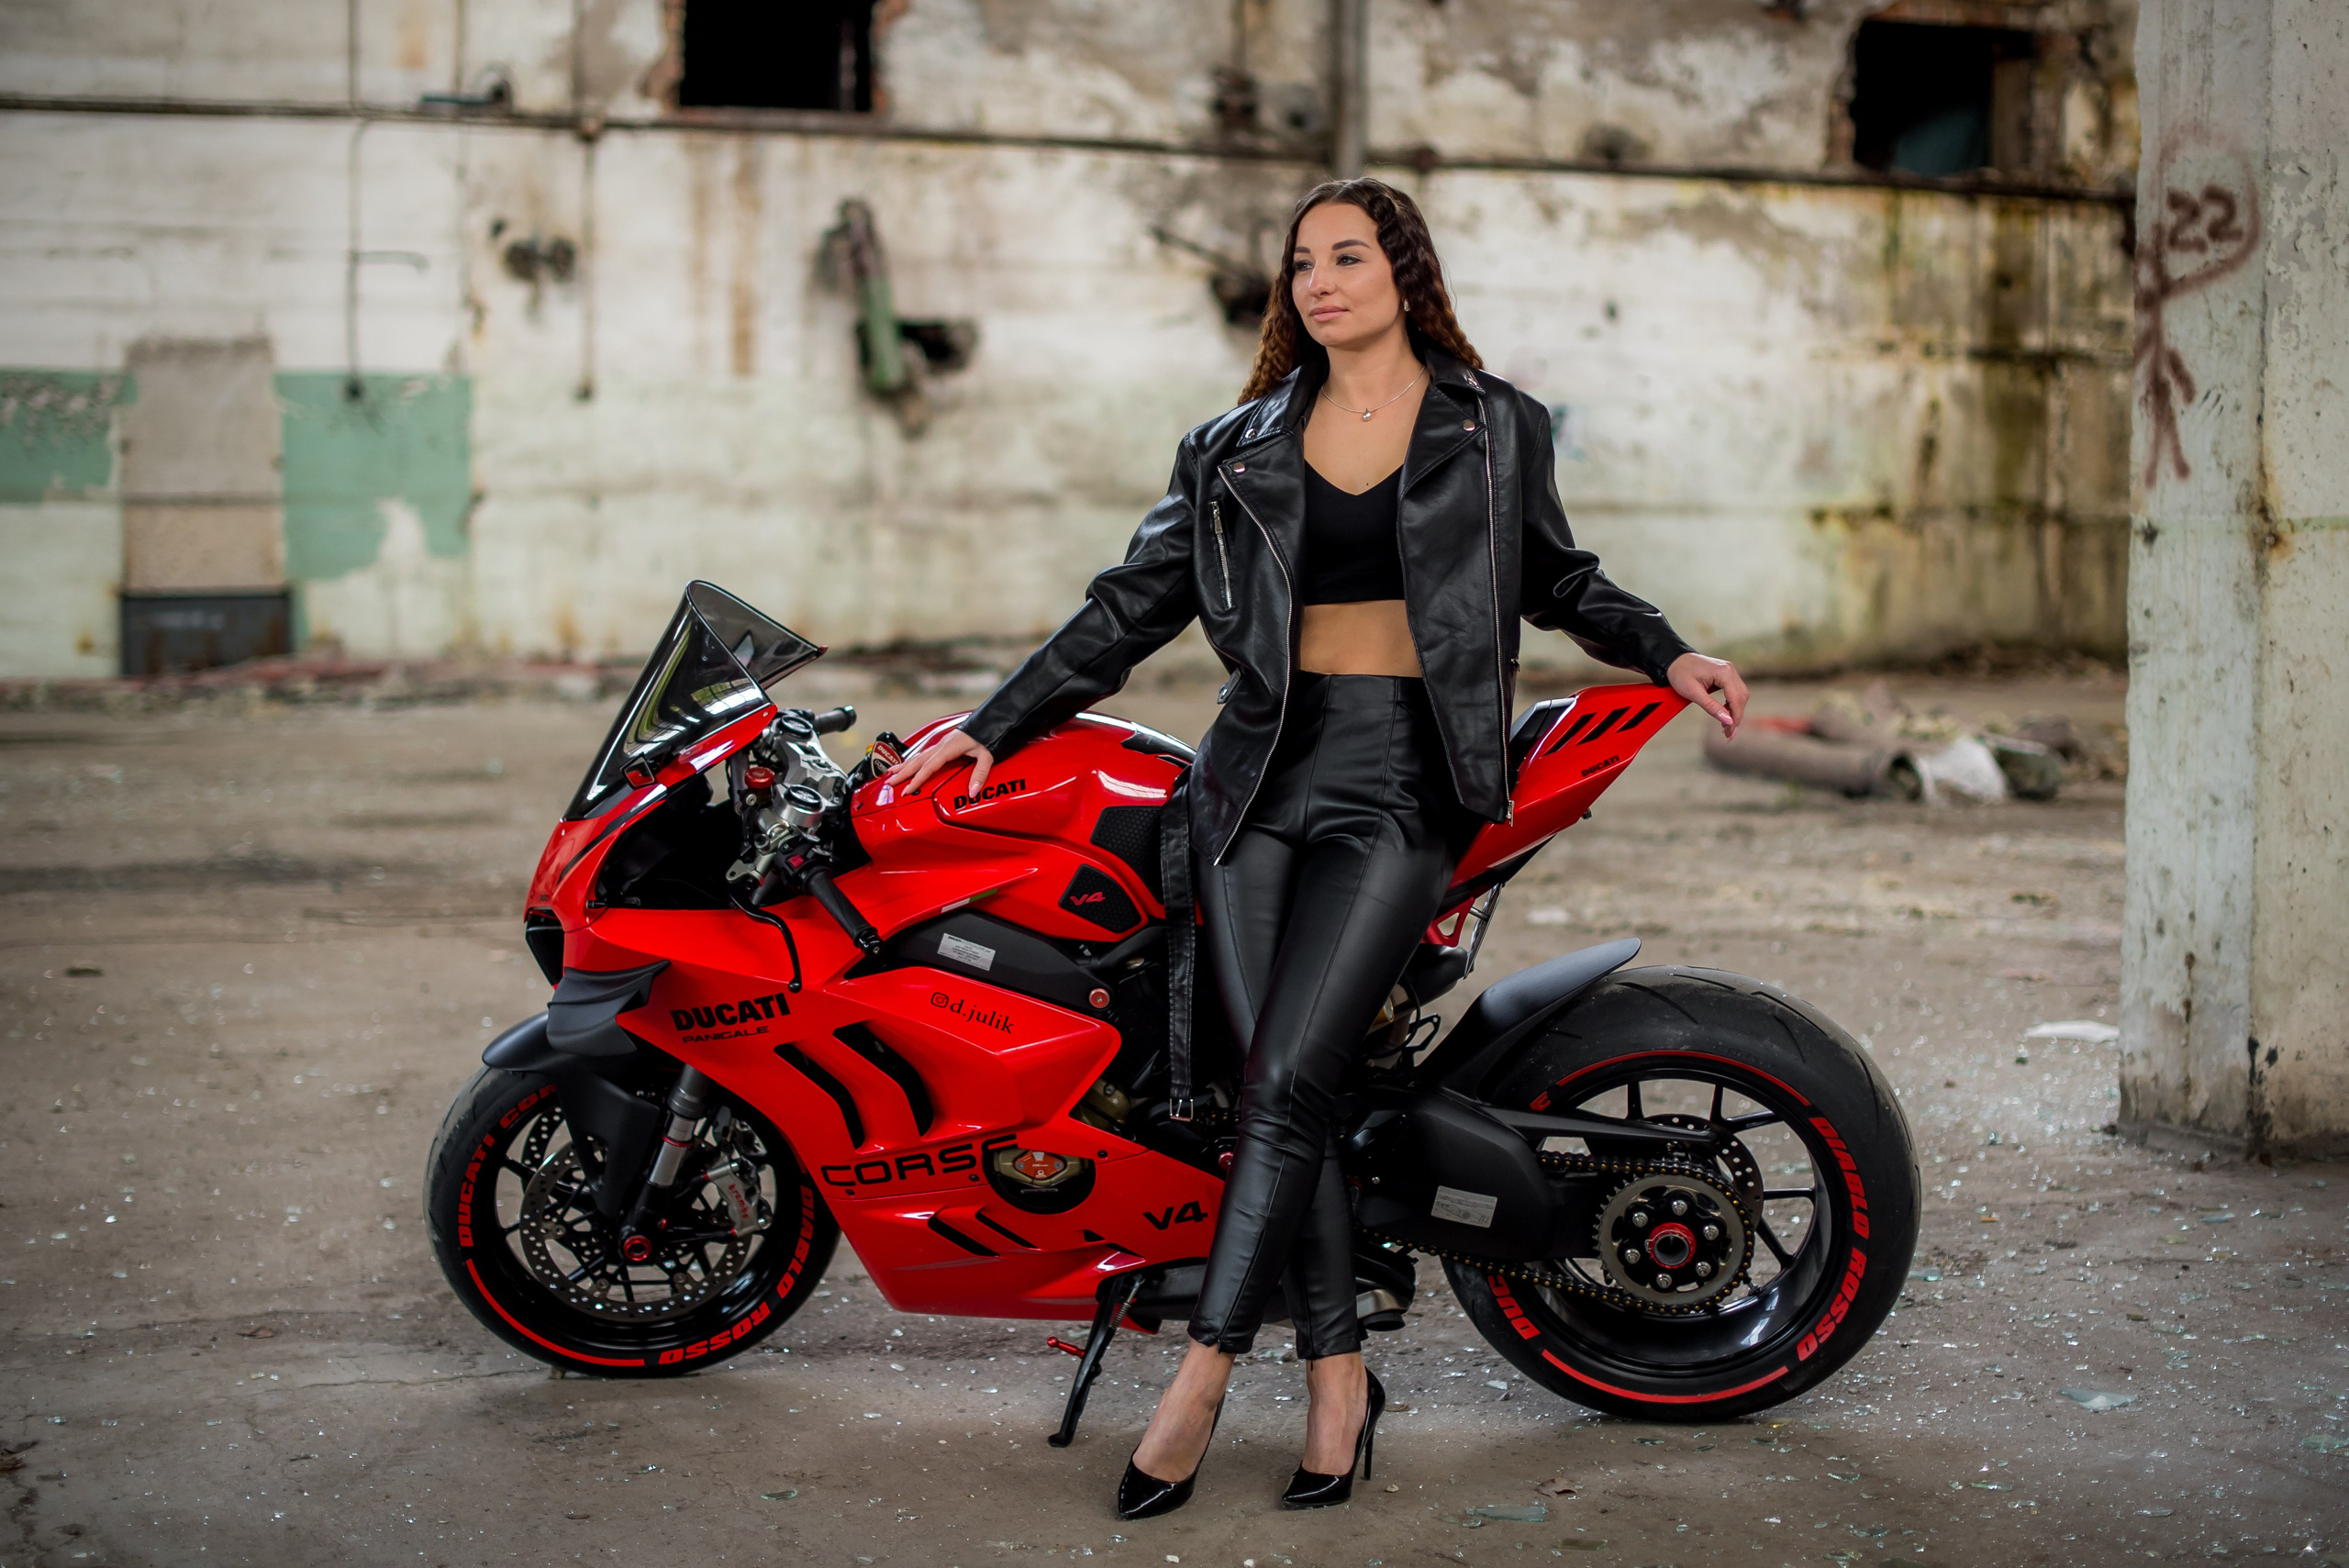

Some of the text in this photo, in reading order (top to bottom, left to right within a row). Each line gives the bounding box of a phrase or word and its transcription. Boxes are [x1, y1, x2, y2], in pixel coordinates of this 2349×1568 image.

[1581, 755, 1620, 776] DUCATI
[954, 779, 1026, 810] DUCATI
[1070, 892, 1106, 906] V4
[670, 993, 791, 1031] DUCATI
[682, 1026, 770, 1043] PANIGALE
[459, 1134, 495, 1248] DUCATI
[1142, 1200, 1208, 1231] V4
[1797, 1117, 1870, 1362] DIABLO ROSSO
[658, 1184, 815, 1365] DIABLO ROSSO
